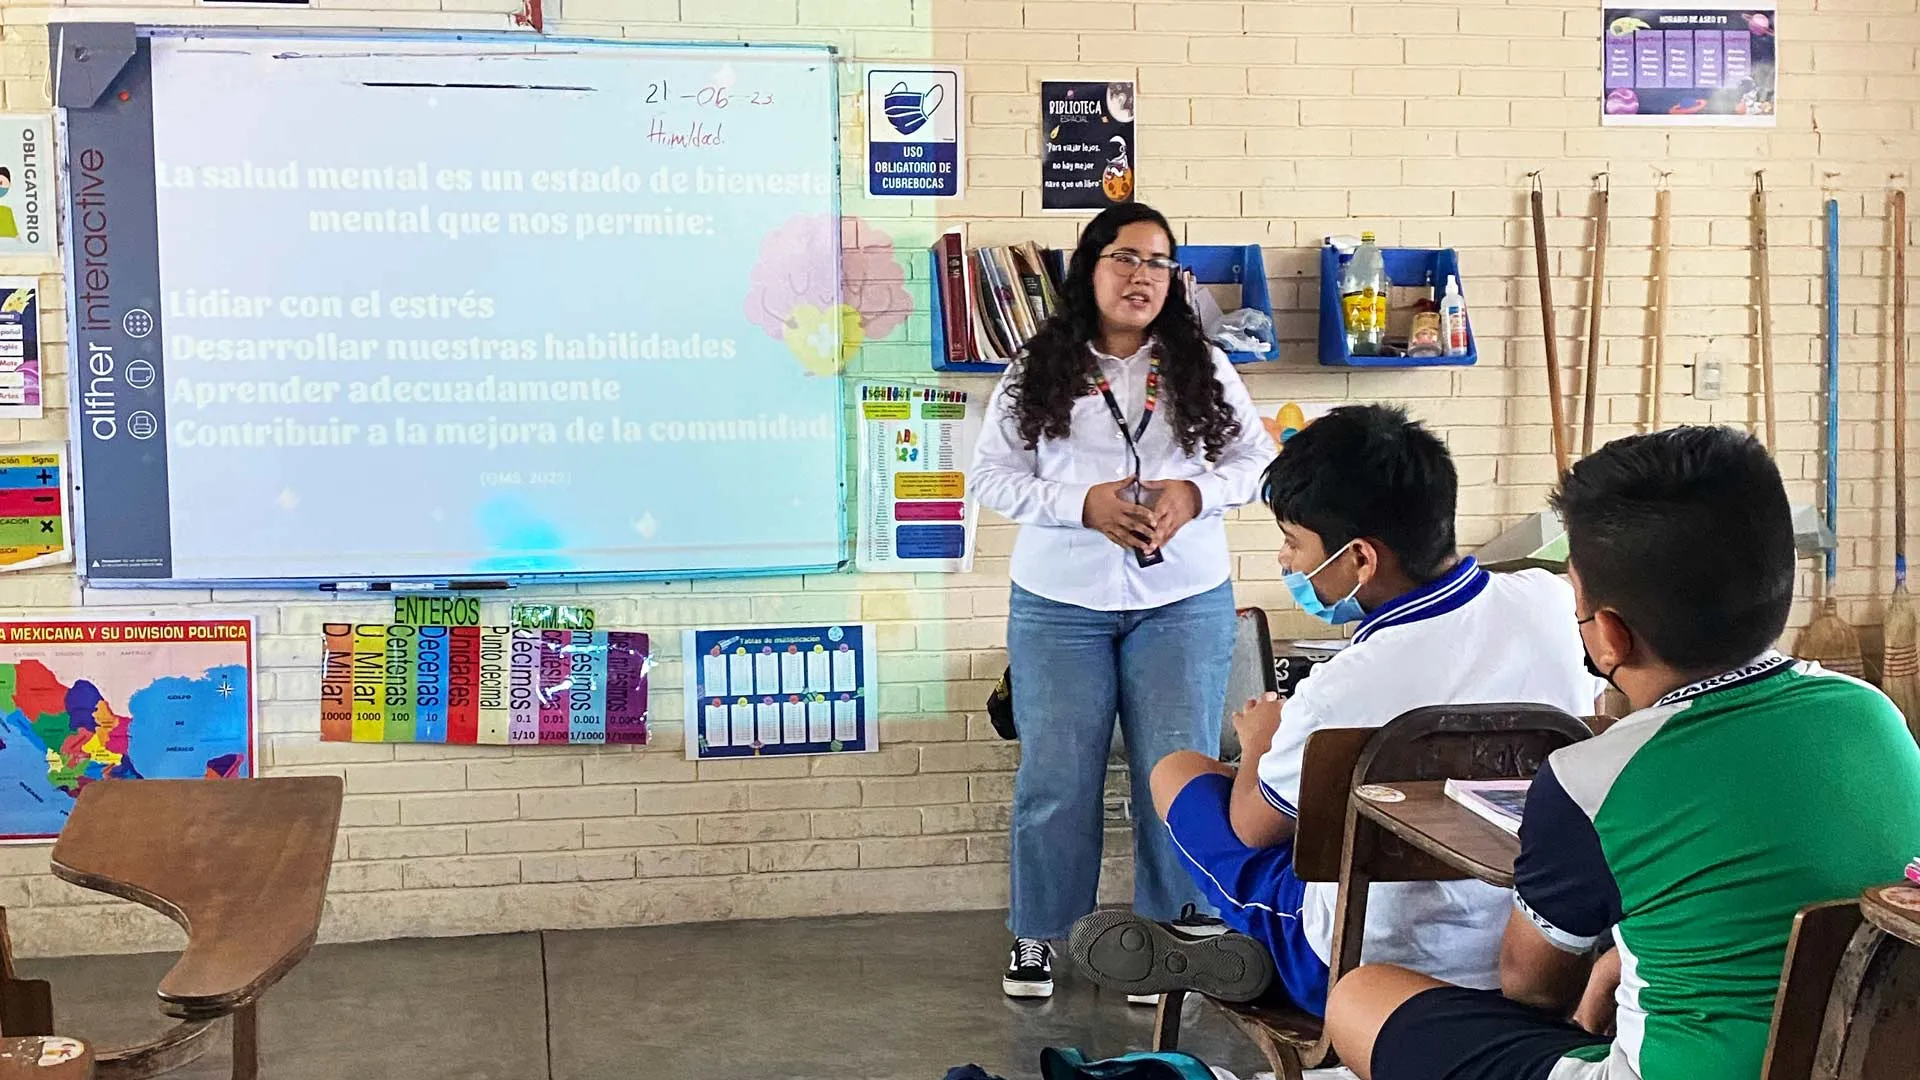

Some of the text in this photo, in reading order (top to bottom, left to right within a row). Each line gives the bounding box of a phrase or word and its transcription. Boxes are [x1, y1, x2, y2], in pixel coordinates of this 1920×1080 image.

[1049, 100, 1102, 115] BIBLIOTECA
[875, 162, 952, 173] OBLIGATORIO DE
[903, 146, 923, 158] USO
[1053, 161, 1095, 172] no hay mejor
[23, 129, 39, 244] OBLIGATORIO
[201, 159, 299, 190] salud
[308, 161, 429, 192] mental
[436, 167, 473, 192] es
[481, 168, 523, 193] un
[531, 165, 642, 194] estado
[650, 166, 689, 193] de
[882, 177, 944, 189] CUBREBOCAS
[1061, 180, 1074, 190] que
[1075, 180, 1083, 188] un
[309, 205, 715, 241] mental que nos permite:
[75, 148, 117, 440] alfher interactive
[170, 288, 495, 319] Lidiar con el estrés
[171, 332, 737, 361] Desarrollar nuestras habilidades
[173, 375, 621, 408] Aprender adecuadamente
[174, 416, 361, 448] Contribuir
[367, 425, 388, 446] a
[396, 417, 428, 446] la
[436, 418, 557, 450] mejora
[565, 416, 605, 444] de
[612, 416, 643, 443] la
[32, 456, 54, 465] Signo
[394, 596, 480, 626] ENTEROS
[11, 627, 84, 641] MEXICANA
[88, 627, 96, 640] Y
[101, 627, 120, 640] SU
[124, 623, 184, 640] DIVISIÓN
[188, 623, 247, 639] POLÍTICA
[321, 651, 352, 705] Millar
[354, 652, 384, 705] Millar
[386, 624, 416, 707] Centenas
[417, 625, 447, 707] Decenas
[448, 625, 480, 707] Unidades
[480, 625, 509, 711] Punto decimal
[510, 628, 540, 710] décimos
[1660, 656, 1782, 705] MARCIANO
[322, 711, 352, 721] 10000
[357, 712, 381, 721] 1000
[391, 713, 410, 722] 100
[426, 713, 438, 722] 10
[460, 714, 465, 722] 1
[516, 714, 531, 723] 0.1
[544, 714, 564, 724] 0.01
[574, 715, 600, 724] 0.001
[512, 731, 535, 740] 1/10
[540, 731, 568, 740] 1/100
[570, 731, 604, 740] 1/1000
